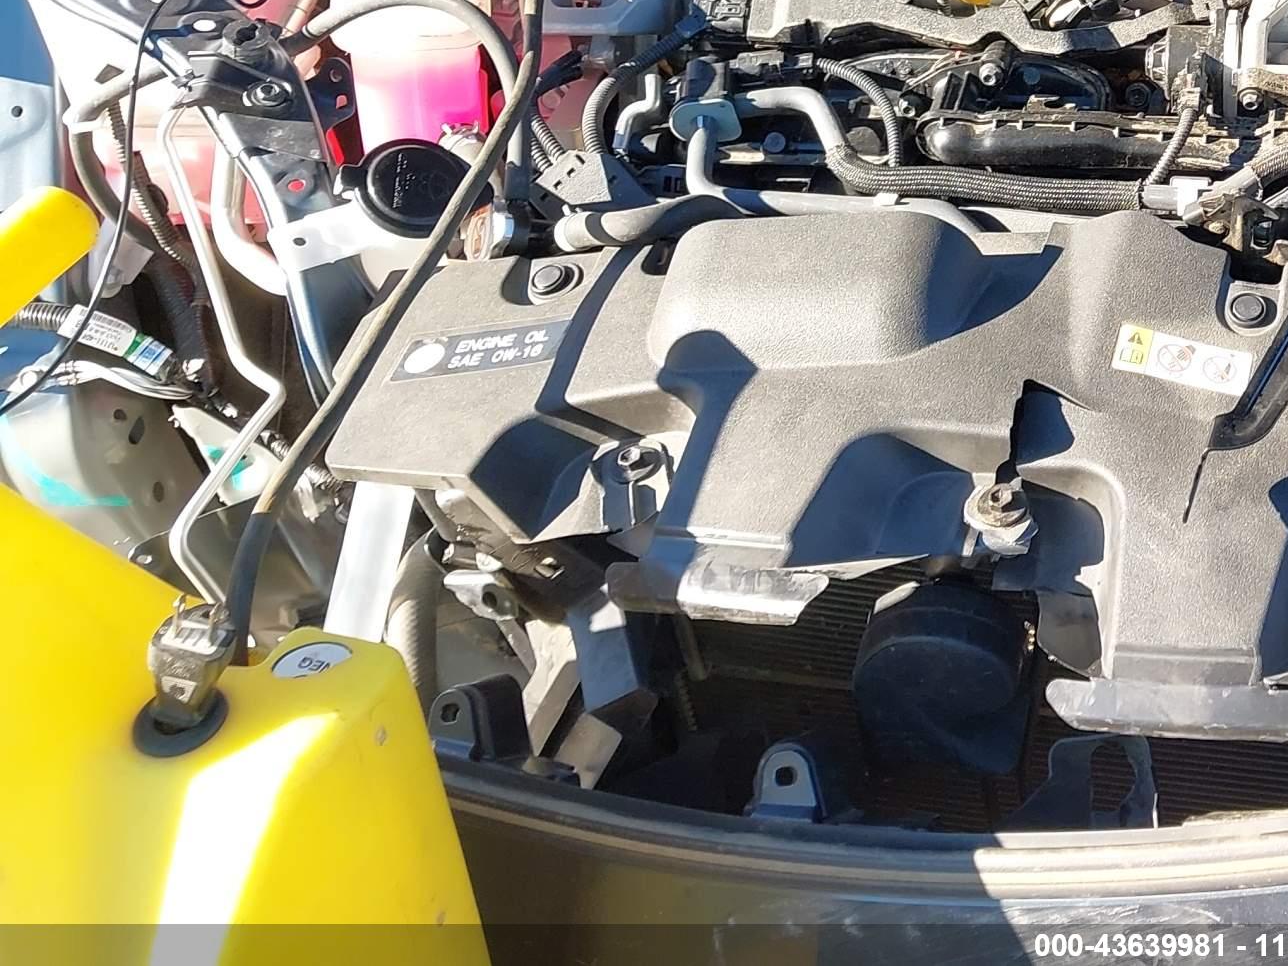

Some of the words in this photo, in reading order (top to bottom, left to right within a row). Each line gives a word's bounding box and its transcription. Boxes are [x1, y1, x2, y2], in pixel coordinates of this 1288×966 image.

[455, 333, 518, 354] ENGINE
[524, 330, 549, 344] OIL
[447, 352, 484, 369] SAE
